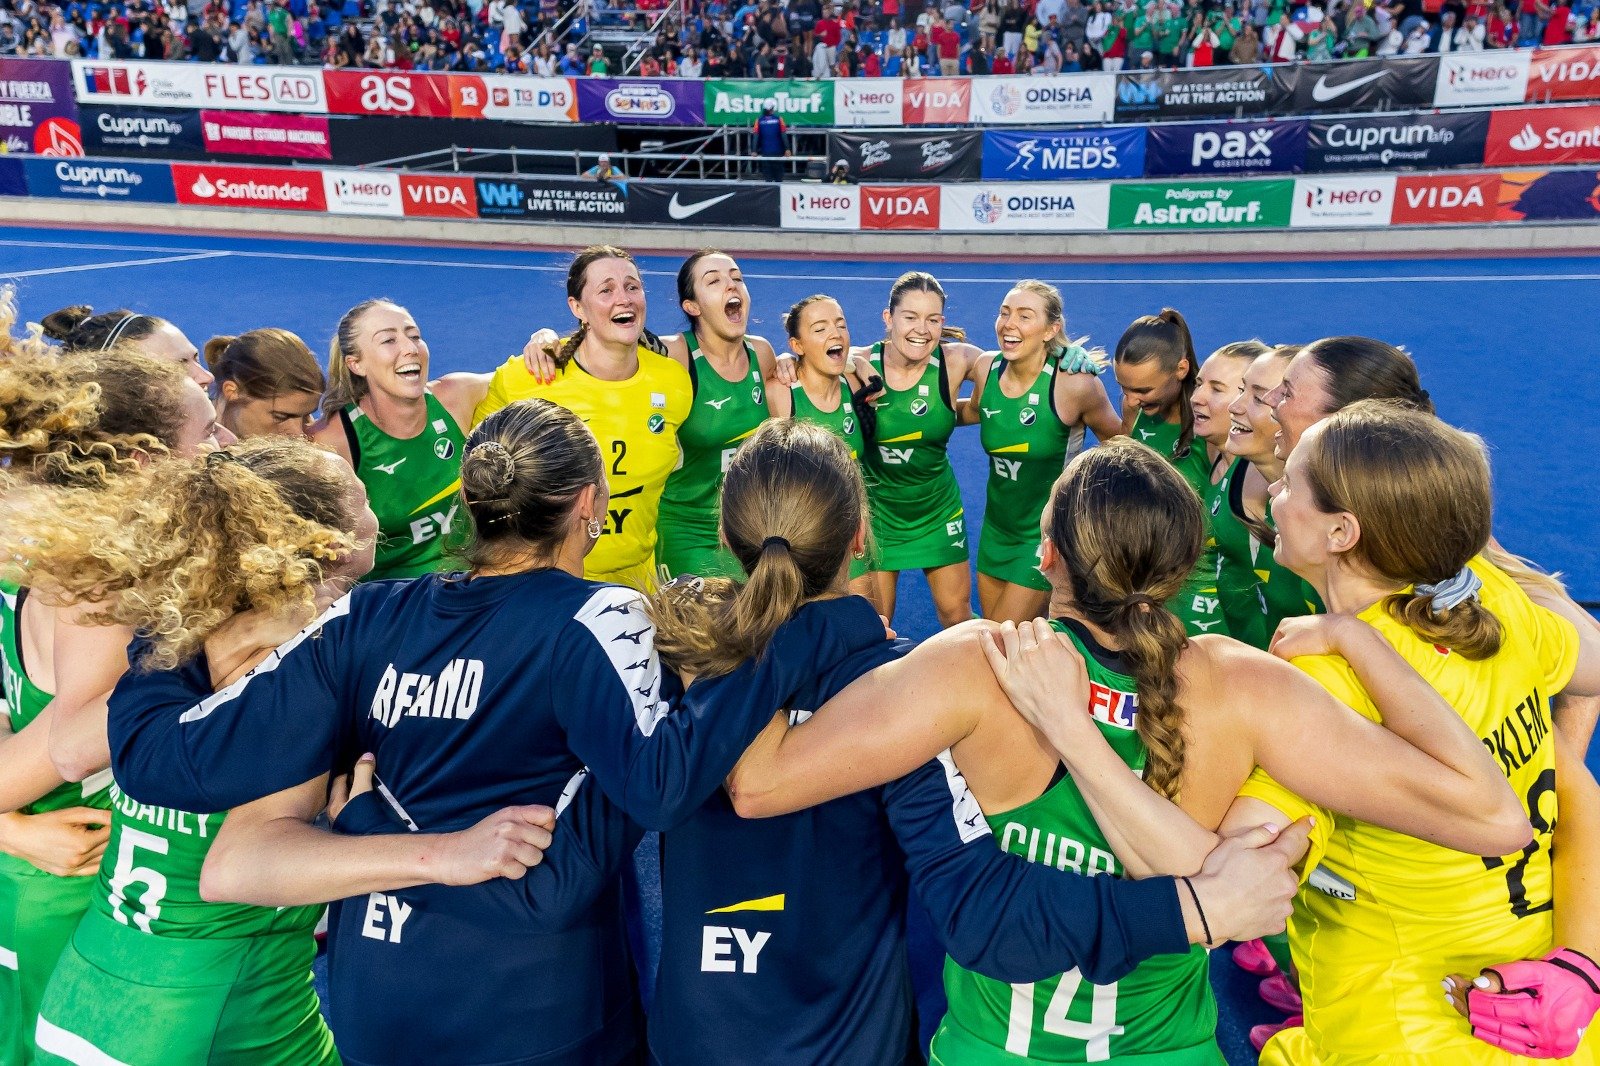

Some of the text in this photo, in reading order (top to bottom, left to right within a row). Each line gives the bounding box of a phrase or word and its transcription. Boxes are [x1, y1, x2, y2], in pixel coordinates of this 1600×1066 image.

[1471, 65, 1517, 80] Hero
[361, 76, 414, 111] as
[860, 92, 894, 104] Hero
[908, 92, 962, 108] VIDA
[1026, 88, 1093, 103] ODISHA
[1164, 90, 1265, 105] LIVE THE ACTION
[1192, 127, 1273, 166] pax
[1042, 147, 1118, 170] MEDS
[216, 179, 309, 202] Santander
[353, 181, 391, 197] Hero
[407, 184, 467, 204] VIDA
[1330, 187, 1382, 204] Hero
[1405, 186, 1485, 208] VIDA
[528, 198, 552, 211] LIVE
[553, 199, 576, 212] THE
[577, 201, 625, 214] ACTION
[810, 196, 850, 210] Hero
[868, 197, 930, 216] VIDA
[1008, 196, 1075, 211] ODISHA
[1134, 201, 1261, 225] AstroTurf
[611, 440, 628, 476] 2
[878, 446, 915, 465] EY
[993, 457, 1022, 481] EY
[410, 504, 458, 544] EY
[946, 517, 964, 536] EY
[1192, 596, 1220, 615] EY
[361, 892, 412, 943] EY
[701, 926, 772, 974] EY
[1005, 965, 1125, 1063] 14
